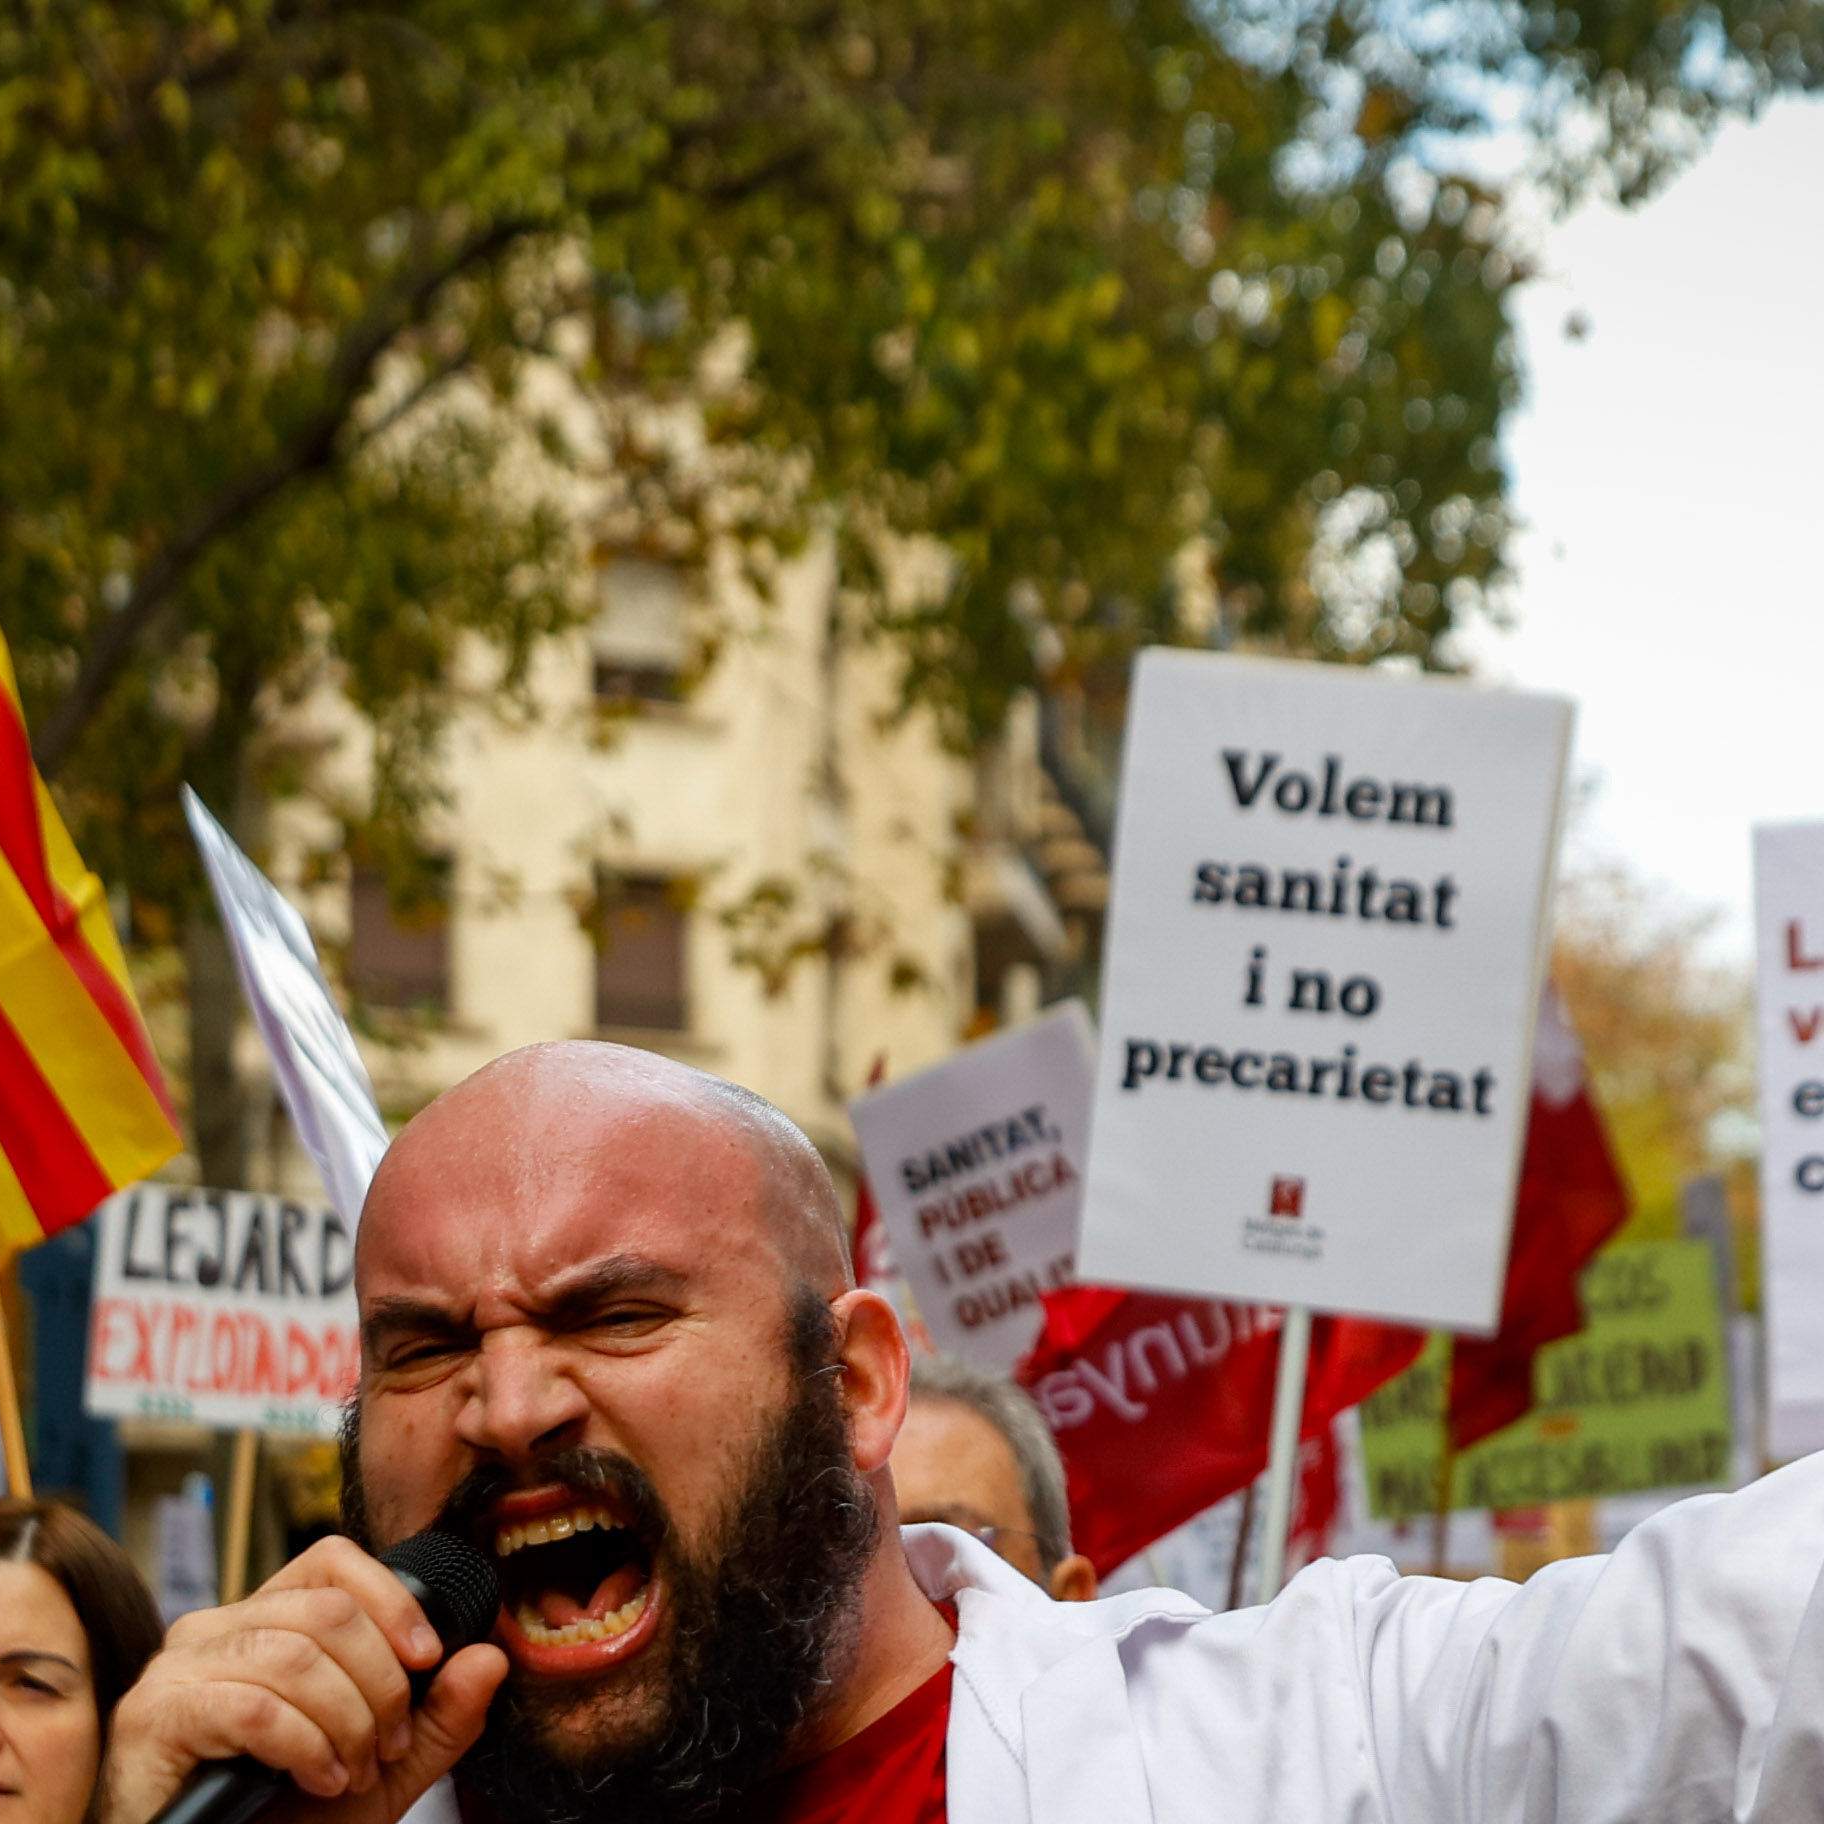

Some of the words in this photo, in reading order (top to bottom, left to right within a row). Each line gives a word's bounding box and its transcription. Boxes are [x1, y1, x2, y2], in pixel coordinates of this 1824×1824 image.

[1222, 749, 1455, 829] Volem
[1193, 853, 1459, 930] sanitat
[1243, 944, 1267, 1008] i
[1286, 966, 1384, 1019] no
[1121, 1037, 1495, 1116] precarietat
[956, 1231, 1008, 1278] DE
